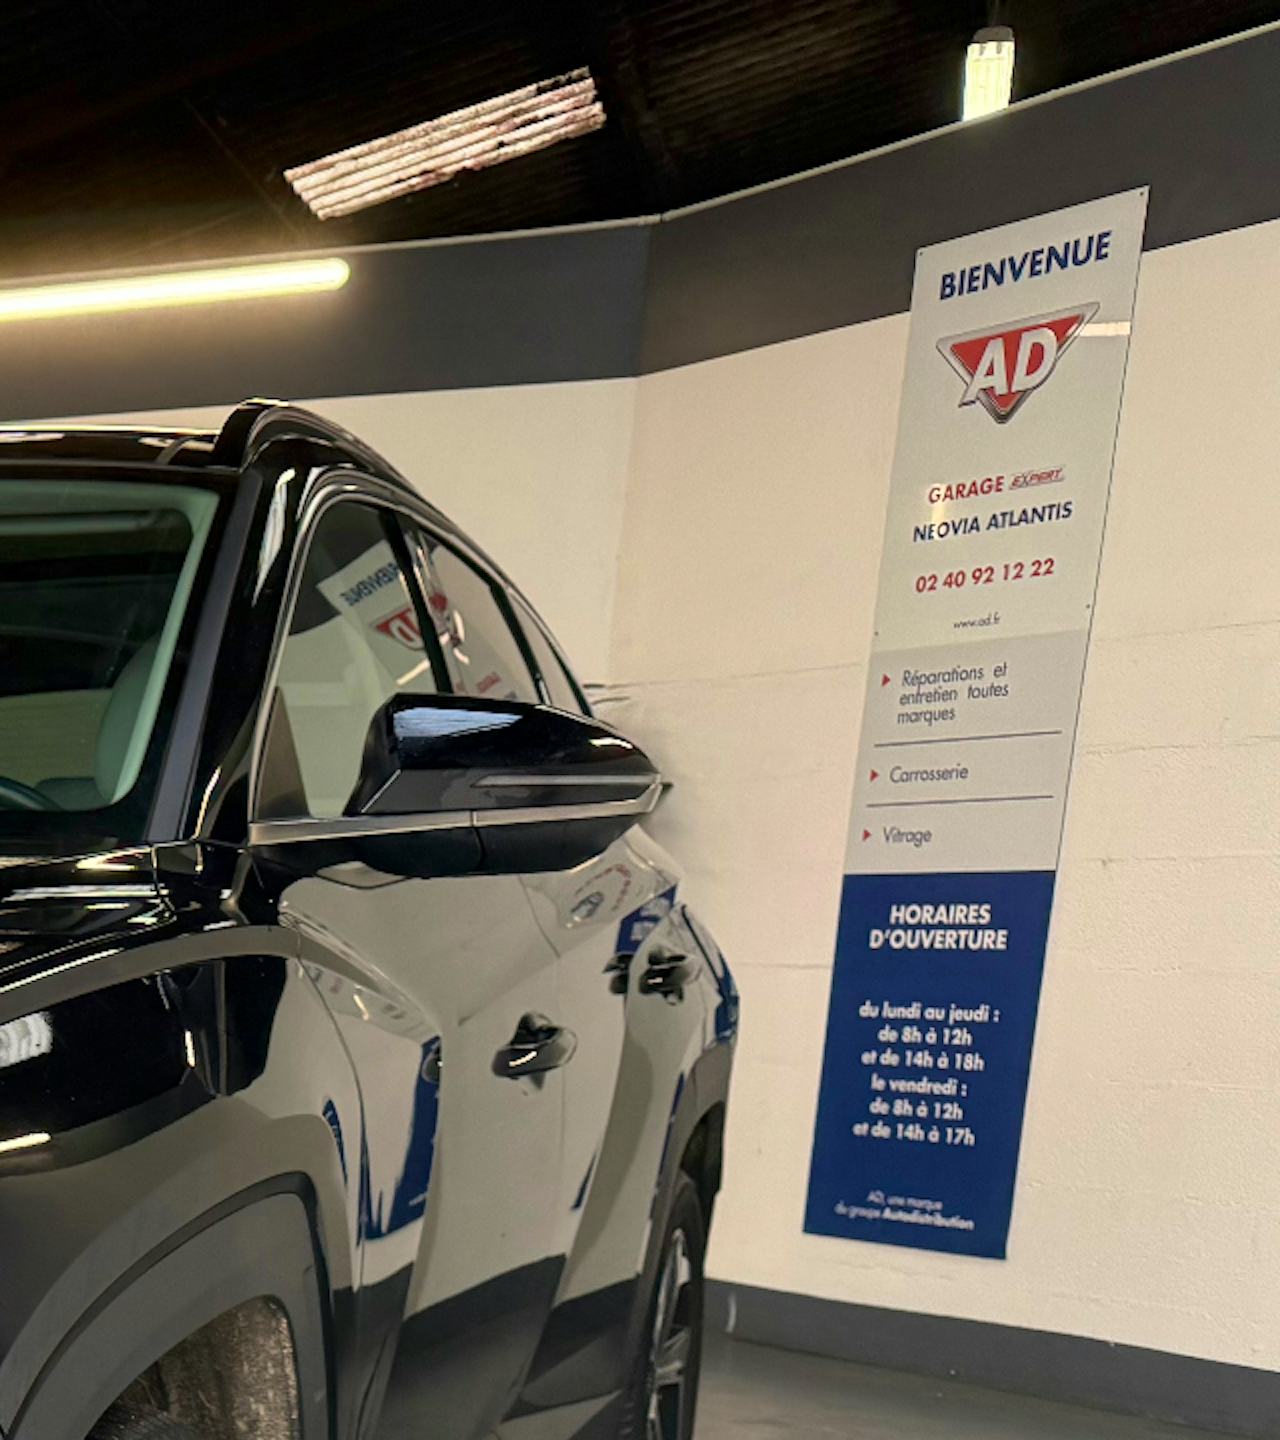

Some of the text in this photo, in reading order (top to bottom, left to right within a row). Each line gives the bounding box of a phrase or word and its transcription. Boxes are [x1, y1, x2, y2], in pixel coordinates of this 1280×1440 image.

[940, 230, 1113, 301] BIENVENUE
[958, 327, 1058, 407] AD
[928, 475, 1005, 504] GARAGE
[913, 501, 1073, 543] NEOVIA ATLANTIS
[915, 557, 1055, 593] 02 40 92 12 22
[953, 611, 1001, 629] www.ad.fr
[901, 662, 1008, 693] Réparations et
[899, 683, 1009, 706] entretien toutes
[897, 708, 956, 727] marques
[890, 763, 969, 783] Carrosserie
[883, 826, 933, 848] Vitrage
[889, 904, 991, 925] HORAIRES
[869, 929, 1008, 949] D'OUVERTURE
[858, 999, 880, 1018] du
[882, 1001, 922, 1019] lundi
[924, 1007, 946, 1020] au
[948, 1003, 990, 1025] jeudi
[877, 1024, 973, 1046] de 8h à 12h
[861, 1048, 985, 1071] et de 14h à 18h
[870, 1073, 886, 1091] le
[889, 1076, 958, 1096] vendredi
[869, 1096, 964, 1121] de 8h à 12h
[852, 1120, 976, 1146] et de 14h à 17h
